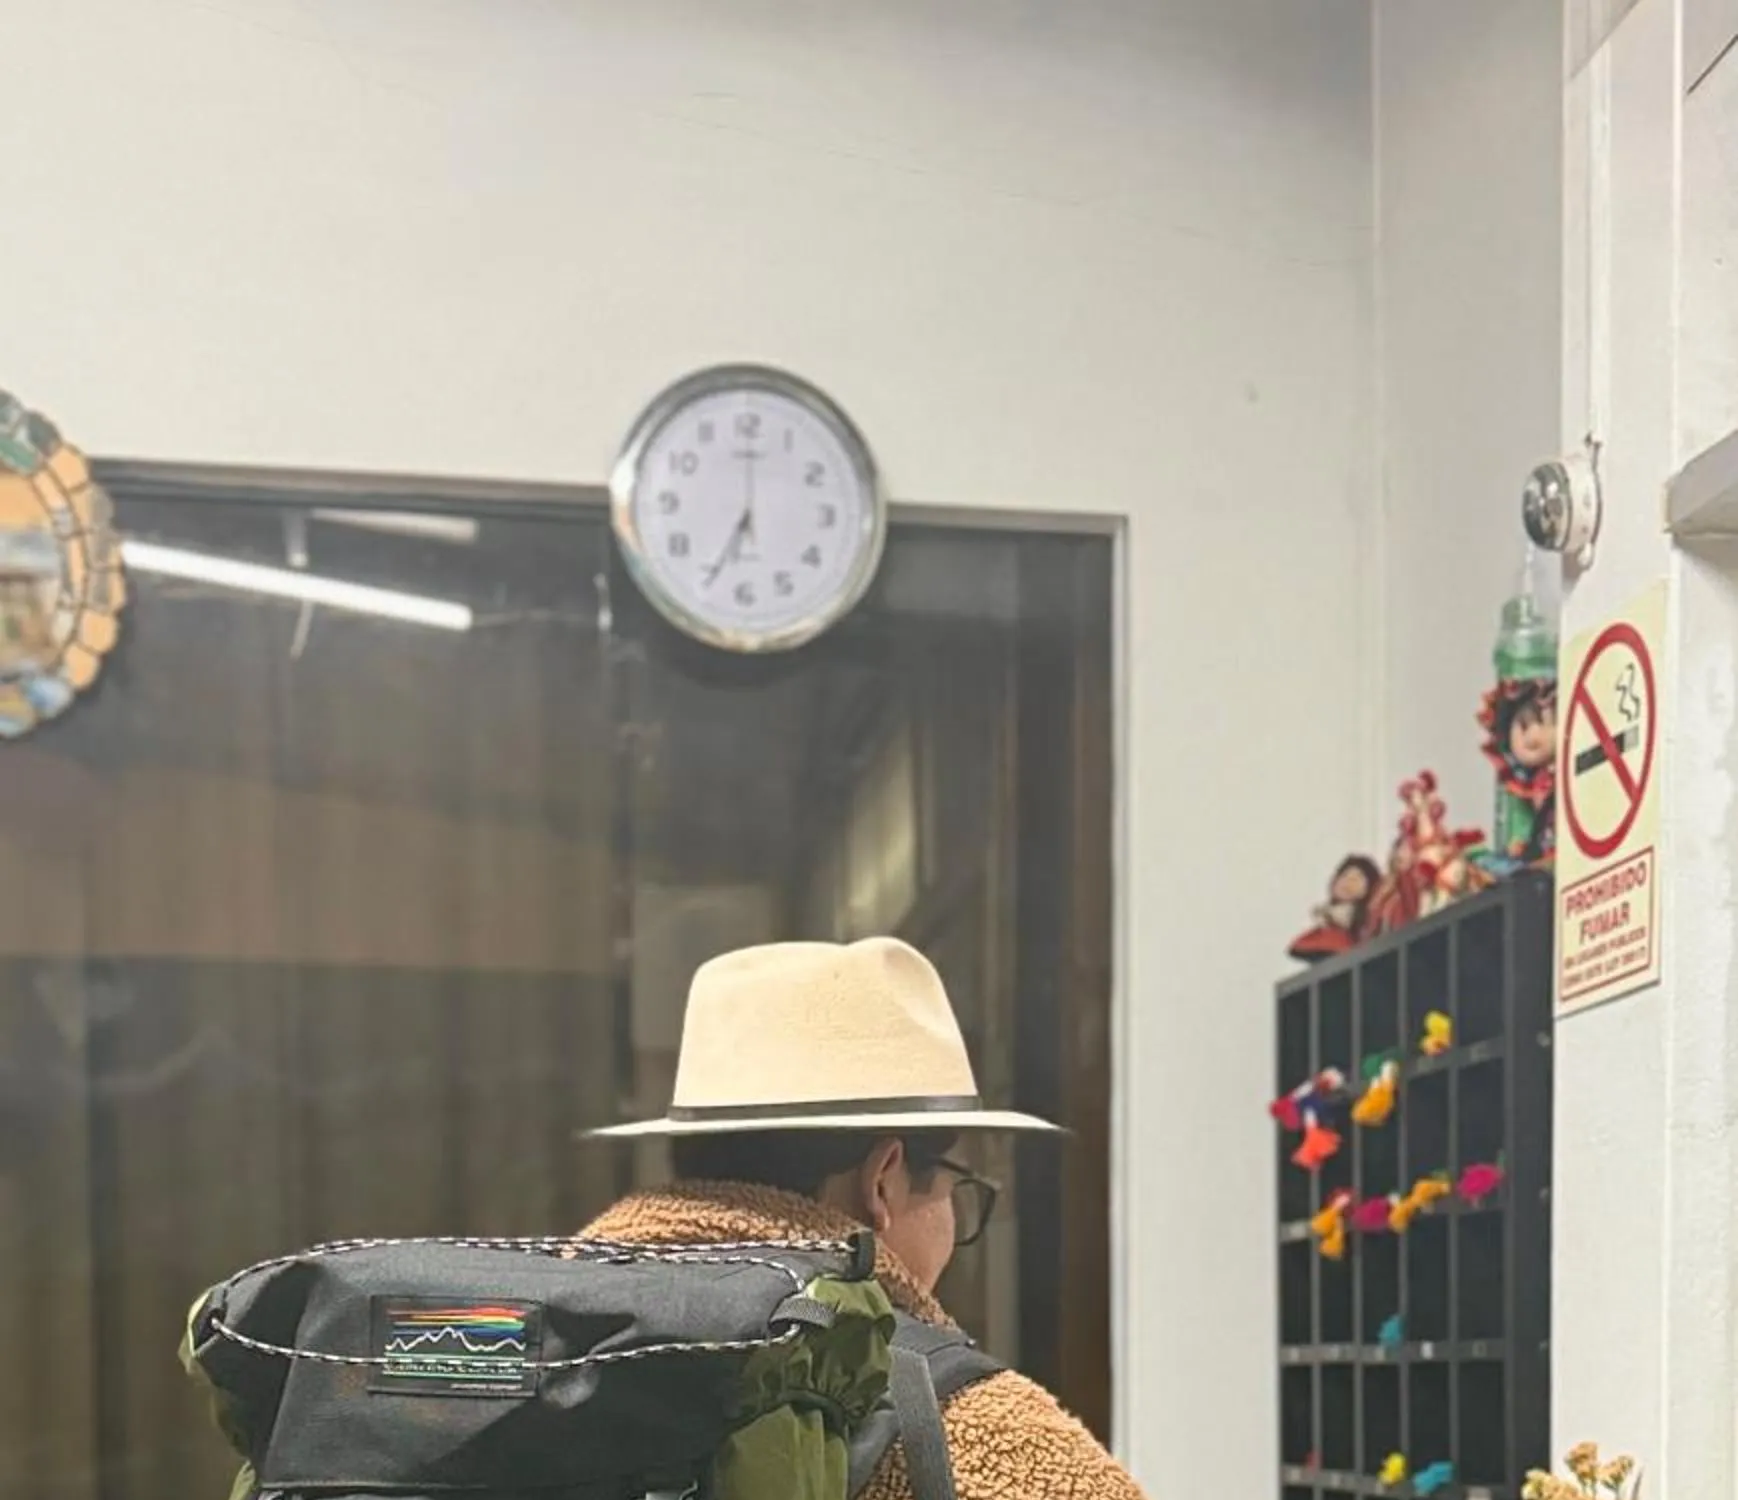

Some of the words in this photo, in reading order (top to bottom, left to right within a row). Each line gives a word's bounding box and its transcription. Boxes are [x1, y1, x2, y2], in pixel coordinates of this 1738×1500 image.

[734, 412, 763, 438] 12
[669, 451, 699, 476] 10
[805, 461, 825, 487] 2
[801, 544, 821, 568] 4
[774, 570, 794, 596] 5
[1566, 860, 1646, 919] PROHIBIDO
[1579, 901, 1630, 945] FUMAR
